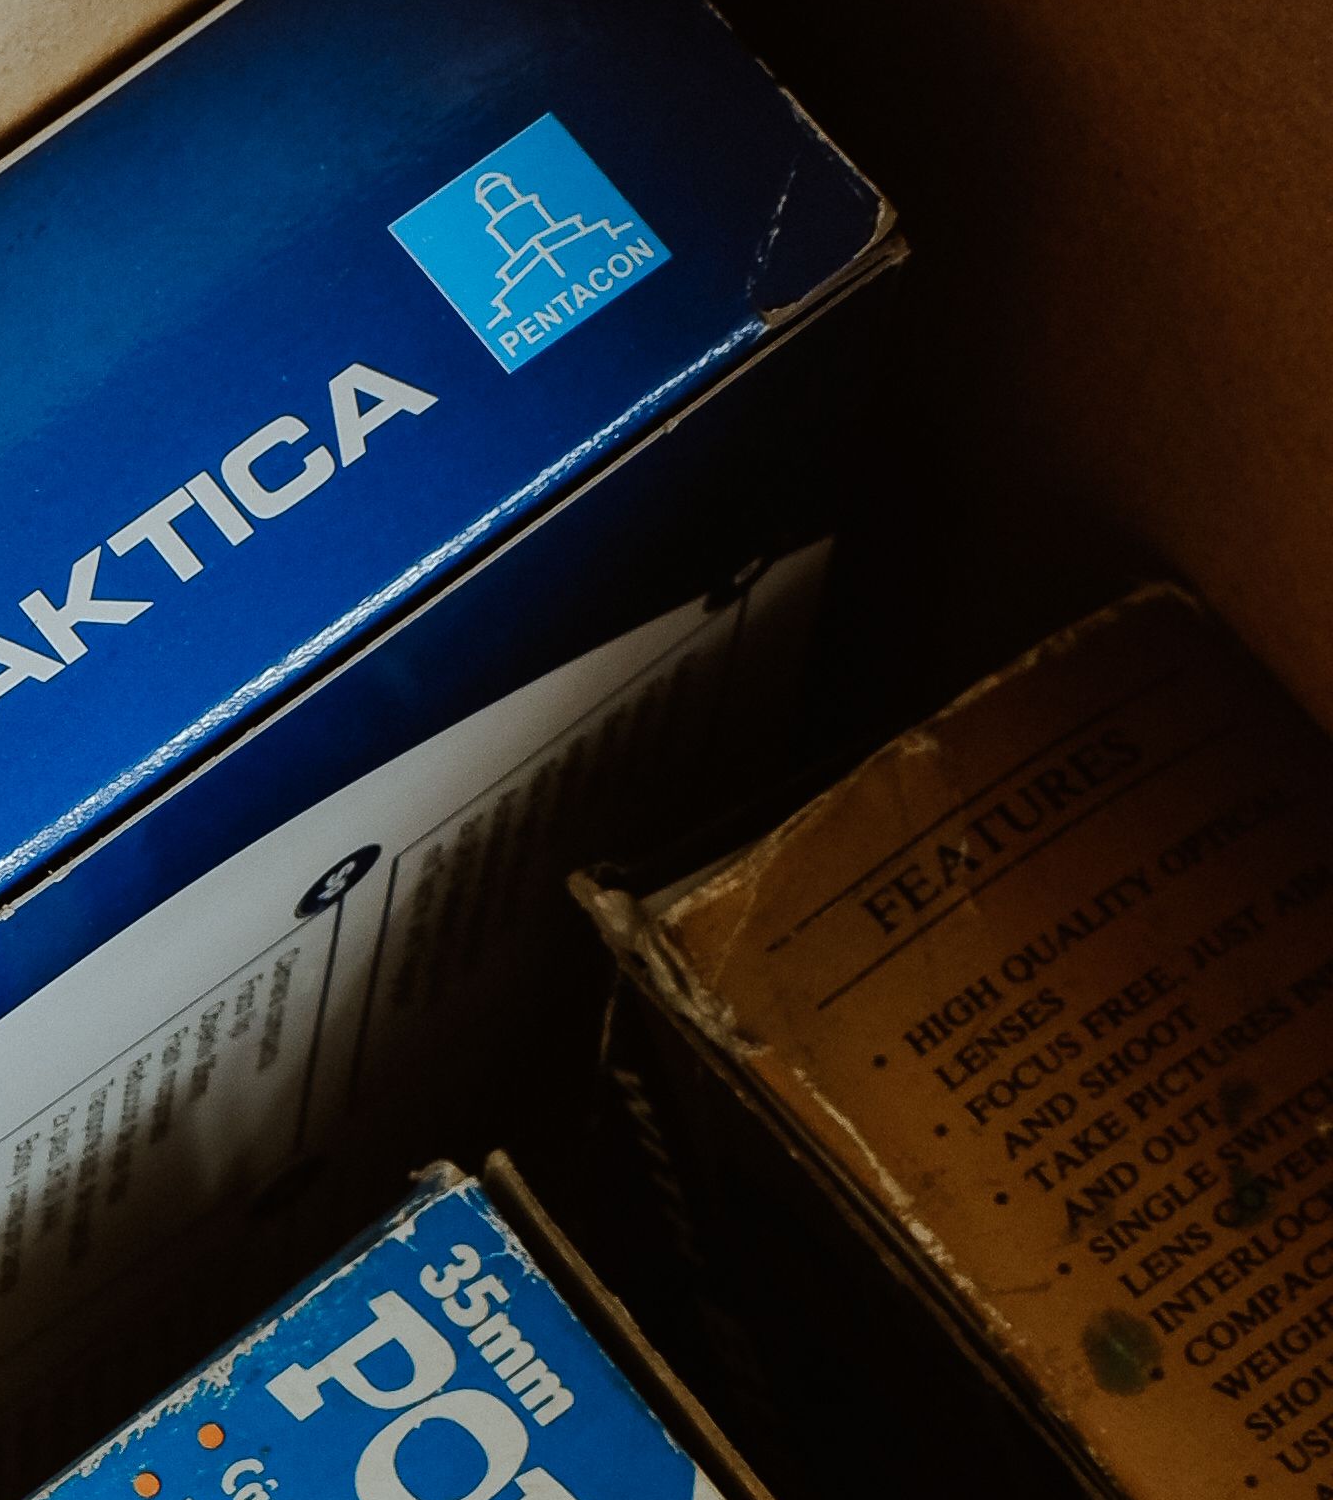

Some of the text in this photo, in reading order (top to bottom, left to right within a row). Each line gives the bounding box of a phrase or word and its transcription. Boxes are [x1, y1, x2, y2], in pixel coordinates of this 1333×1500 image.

[495, 235, 658, 359] PENTACON
[859, 727, 1143, 936] FEATURES
[902, 974, 1005, 1057] HIGH
[1000, 866, 1154, 983] QUALITY
[932, 985, 1066, 1092] LENSES
[963, 1030, 1084, 1127] FOCUS
[1184, 903, 1266, 971] JUST
[1002, 1002, 1197, 1162] AND SHOOT
[1022, 1110, 1130, 1193] TAKE
[1123, 997, 1296, 1121] PICTURES
[1064, 1100, 1218, 1233] AND OUT
[1087, 1159, 1219, 1265] SINGLE
[419, 1243, 575, 1427] 35mm
[1118, 1221, 1214, 1298] LENS
